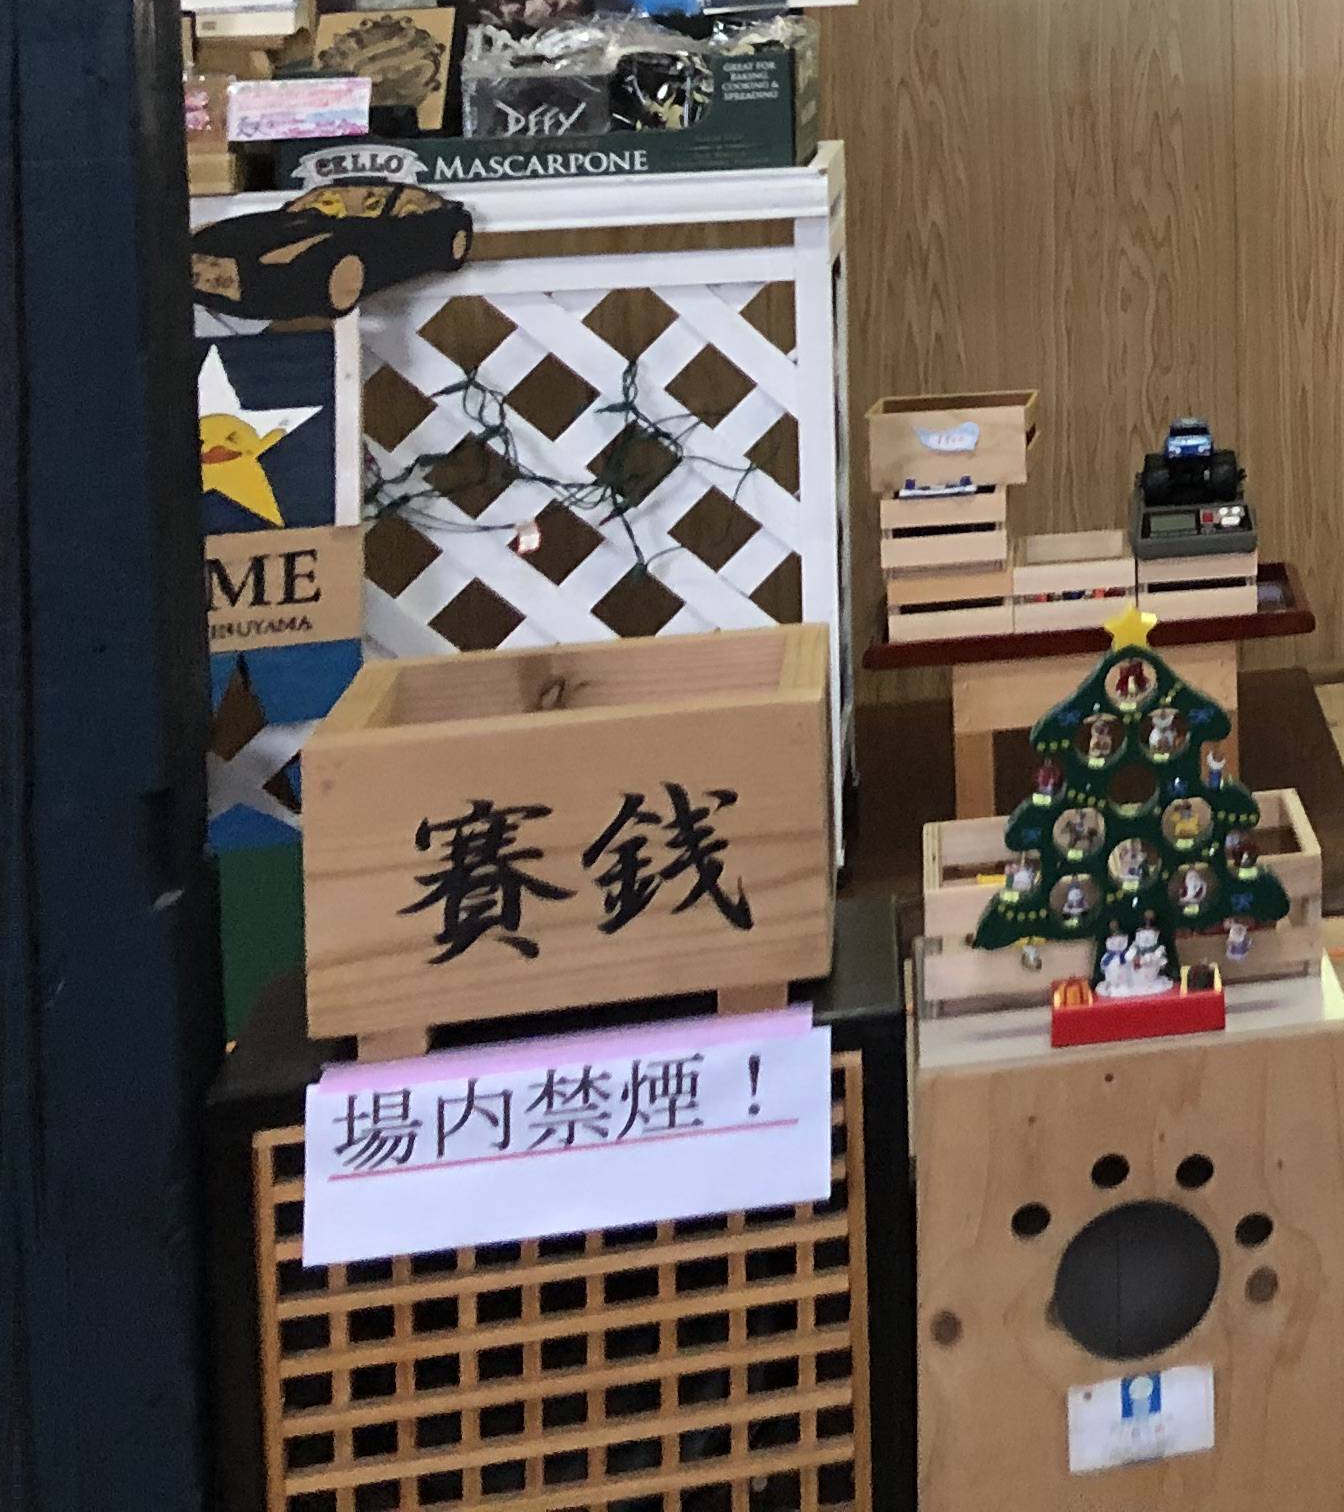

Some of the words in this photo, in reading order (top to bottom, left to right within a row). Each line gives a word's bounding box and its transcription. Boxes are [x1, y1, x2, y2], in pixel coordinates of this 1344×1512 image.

[755, 61, 776, 71] FOR
[314, 152, 407, 178] CELLO
[432, 147, 650, 181] MASCARPONE
[398, 782, 754, 965] 賽銭
